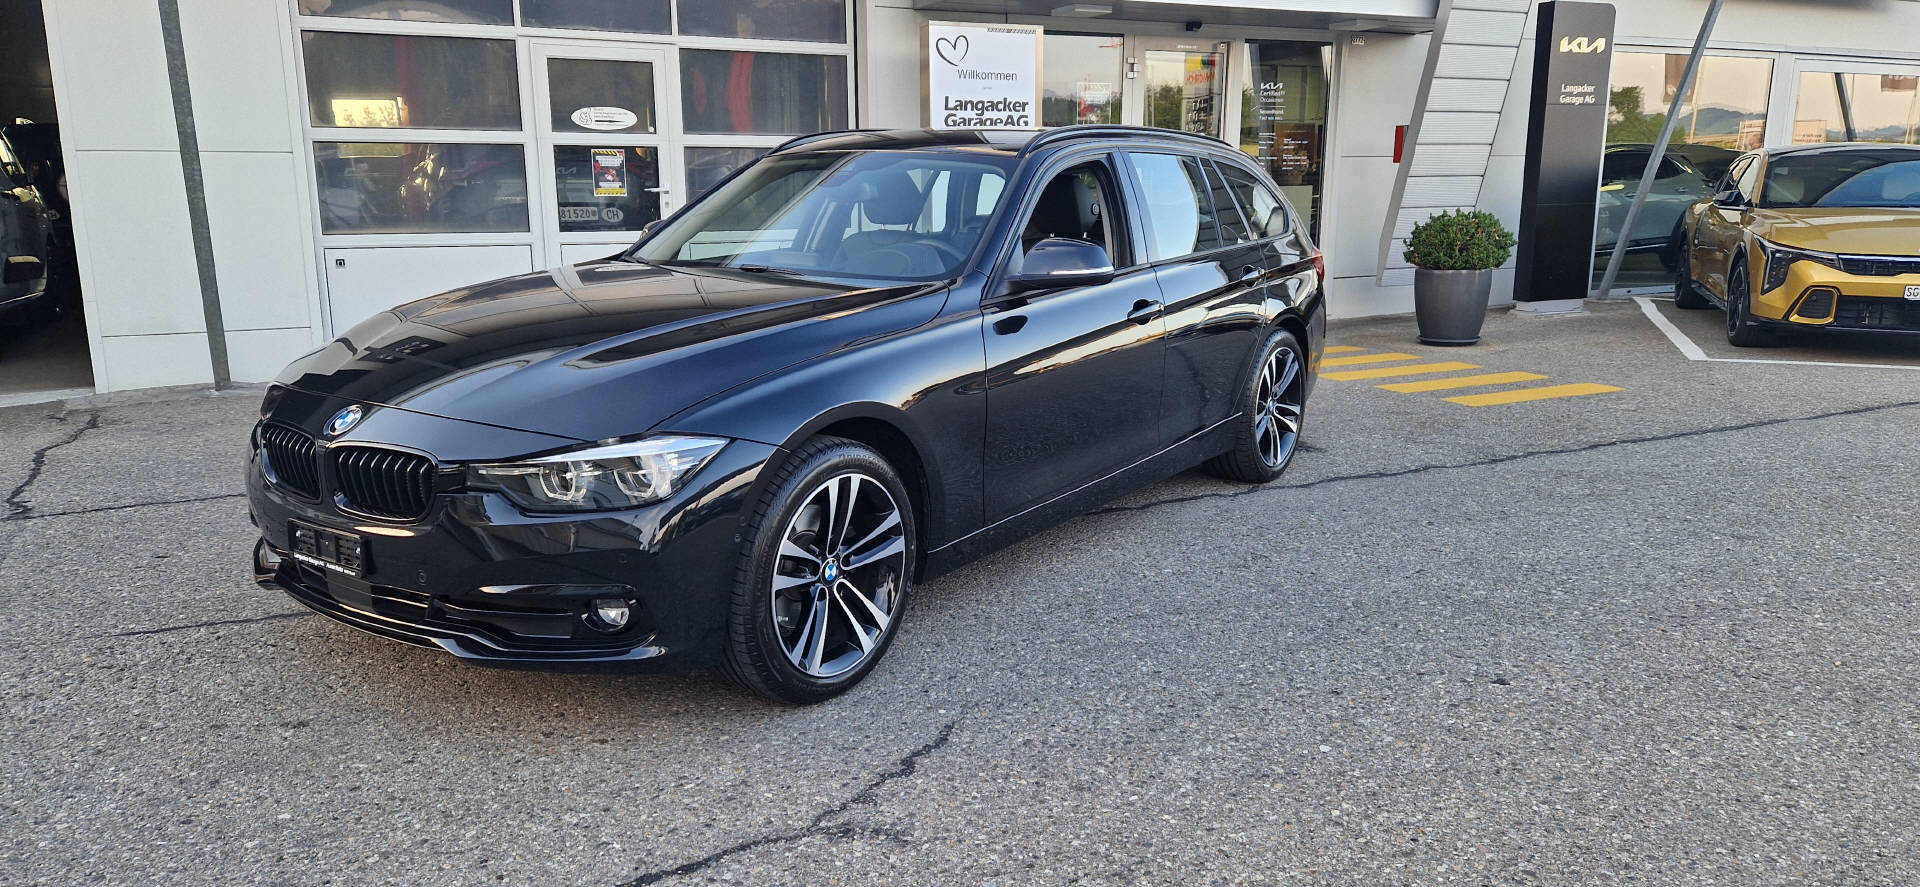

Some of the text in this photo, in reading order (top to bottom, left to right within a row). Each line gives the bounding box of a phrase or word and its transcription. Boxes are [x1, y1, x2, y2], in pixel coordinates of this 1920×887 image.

[957, 69, 1017, 80] Willkommen
[1561, 84, 1595, 94] Langacker
[944, 95, 1029, 116] Langacker
[1560, 95, 1595, 105] Garage AG
[560, 208, 591, 219] 81520
[606, 209, 620, 220] CH
[1906, 287, 1920, 297] SG
